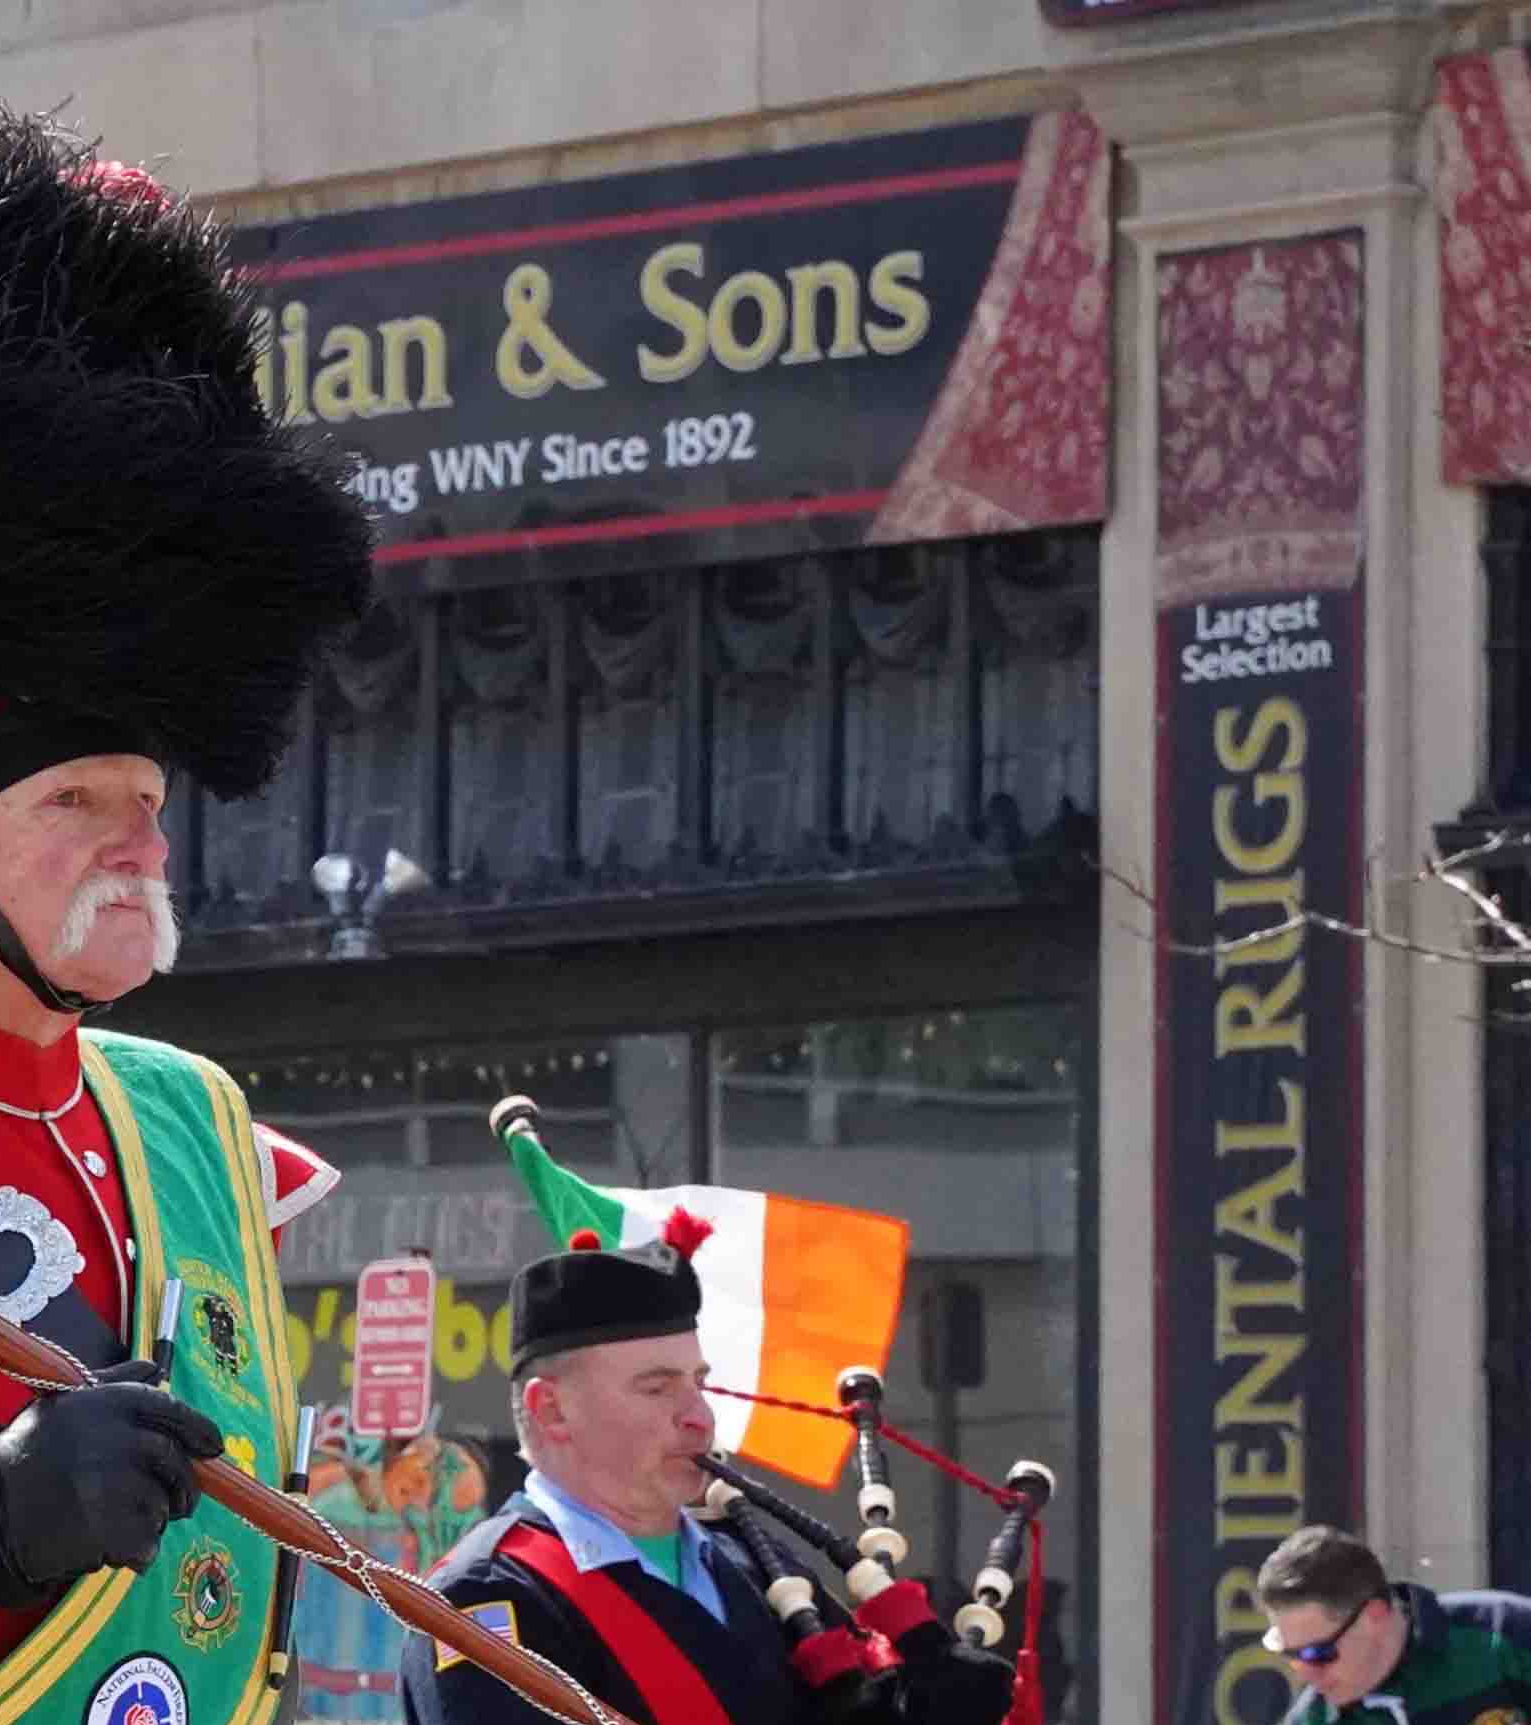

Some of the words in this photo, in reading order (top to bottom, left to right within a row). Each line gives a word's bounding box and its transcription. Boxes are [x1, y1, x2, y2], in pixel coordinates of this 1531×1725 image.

[495, 263, 608, 399] &
[637, 242, 931, 384] Sons
[429, 438, 533, 496] WNY
[540, 432, 650, 485] Since
[662, 411, 758, 468] 1892
[1180, 637, 1334, 684] Selection
[1194, 596, 1320, 646] Largest
[1212, 696, 1310, 1059] RUGS
